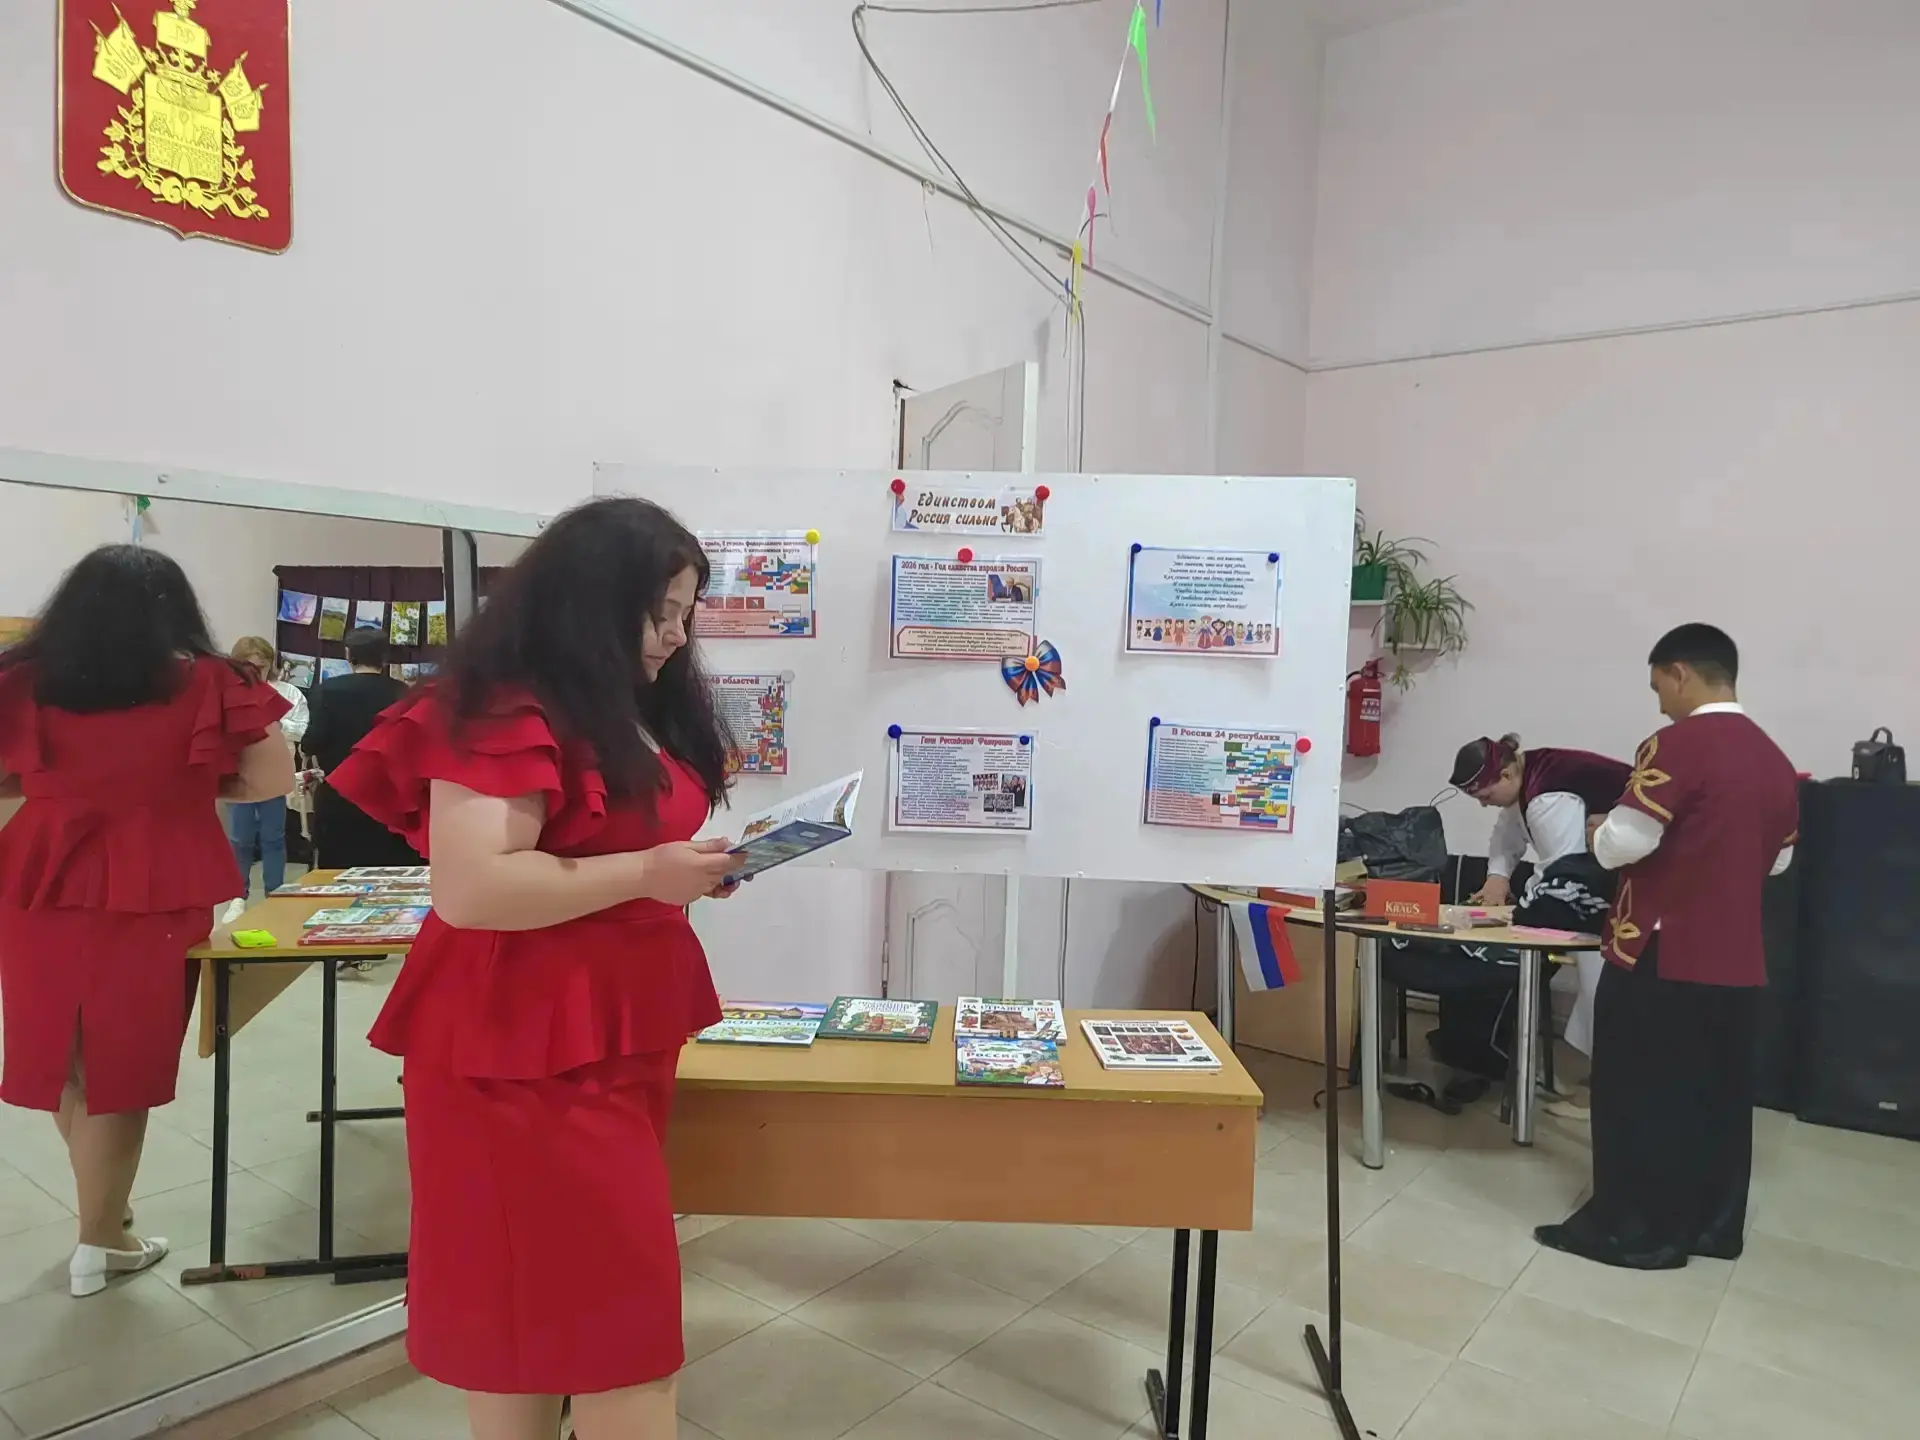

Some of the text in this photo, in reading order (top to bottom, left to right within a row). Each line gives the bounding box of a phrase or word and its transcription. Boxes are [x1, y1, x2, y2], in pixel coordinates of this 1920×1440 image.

[917, 491, 996, 509] Единством
[909, 509, 998, 527] Россия сильна
[918, 563, 930, 571] год
[934, 563, 947, 572] Год
[948, 564, 977, 572] единства
[1006, 564, 1029, 573] России
[722, 676, 760, 685] областей
[1171, 727, 1281, 742] В России 24 республики
